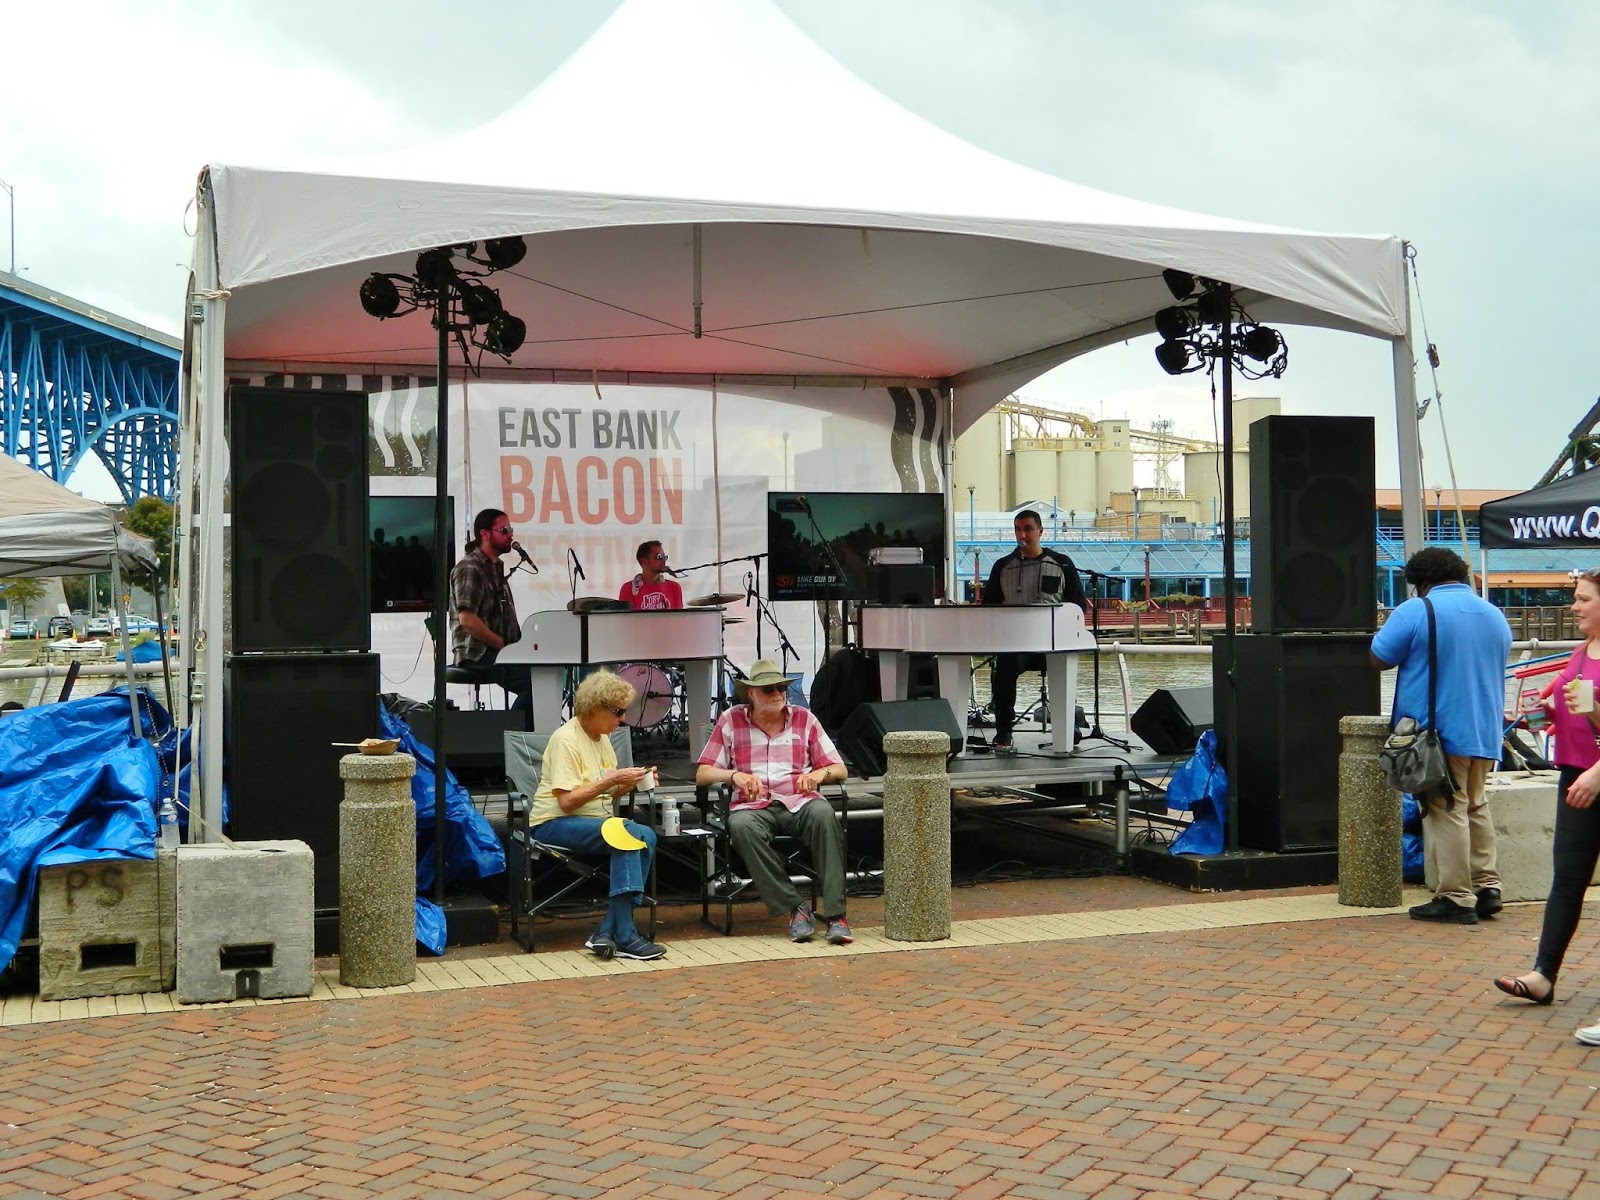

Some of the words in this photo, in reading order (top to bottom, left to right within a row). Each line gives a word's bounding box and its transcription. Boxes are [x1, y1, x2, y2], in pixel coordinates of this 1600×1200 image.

[498, 407, 582, 448] EAST
[592, 409, 683, 450] BANK
[500, 455, 684, 525] BACON
